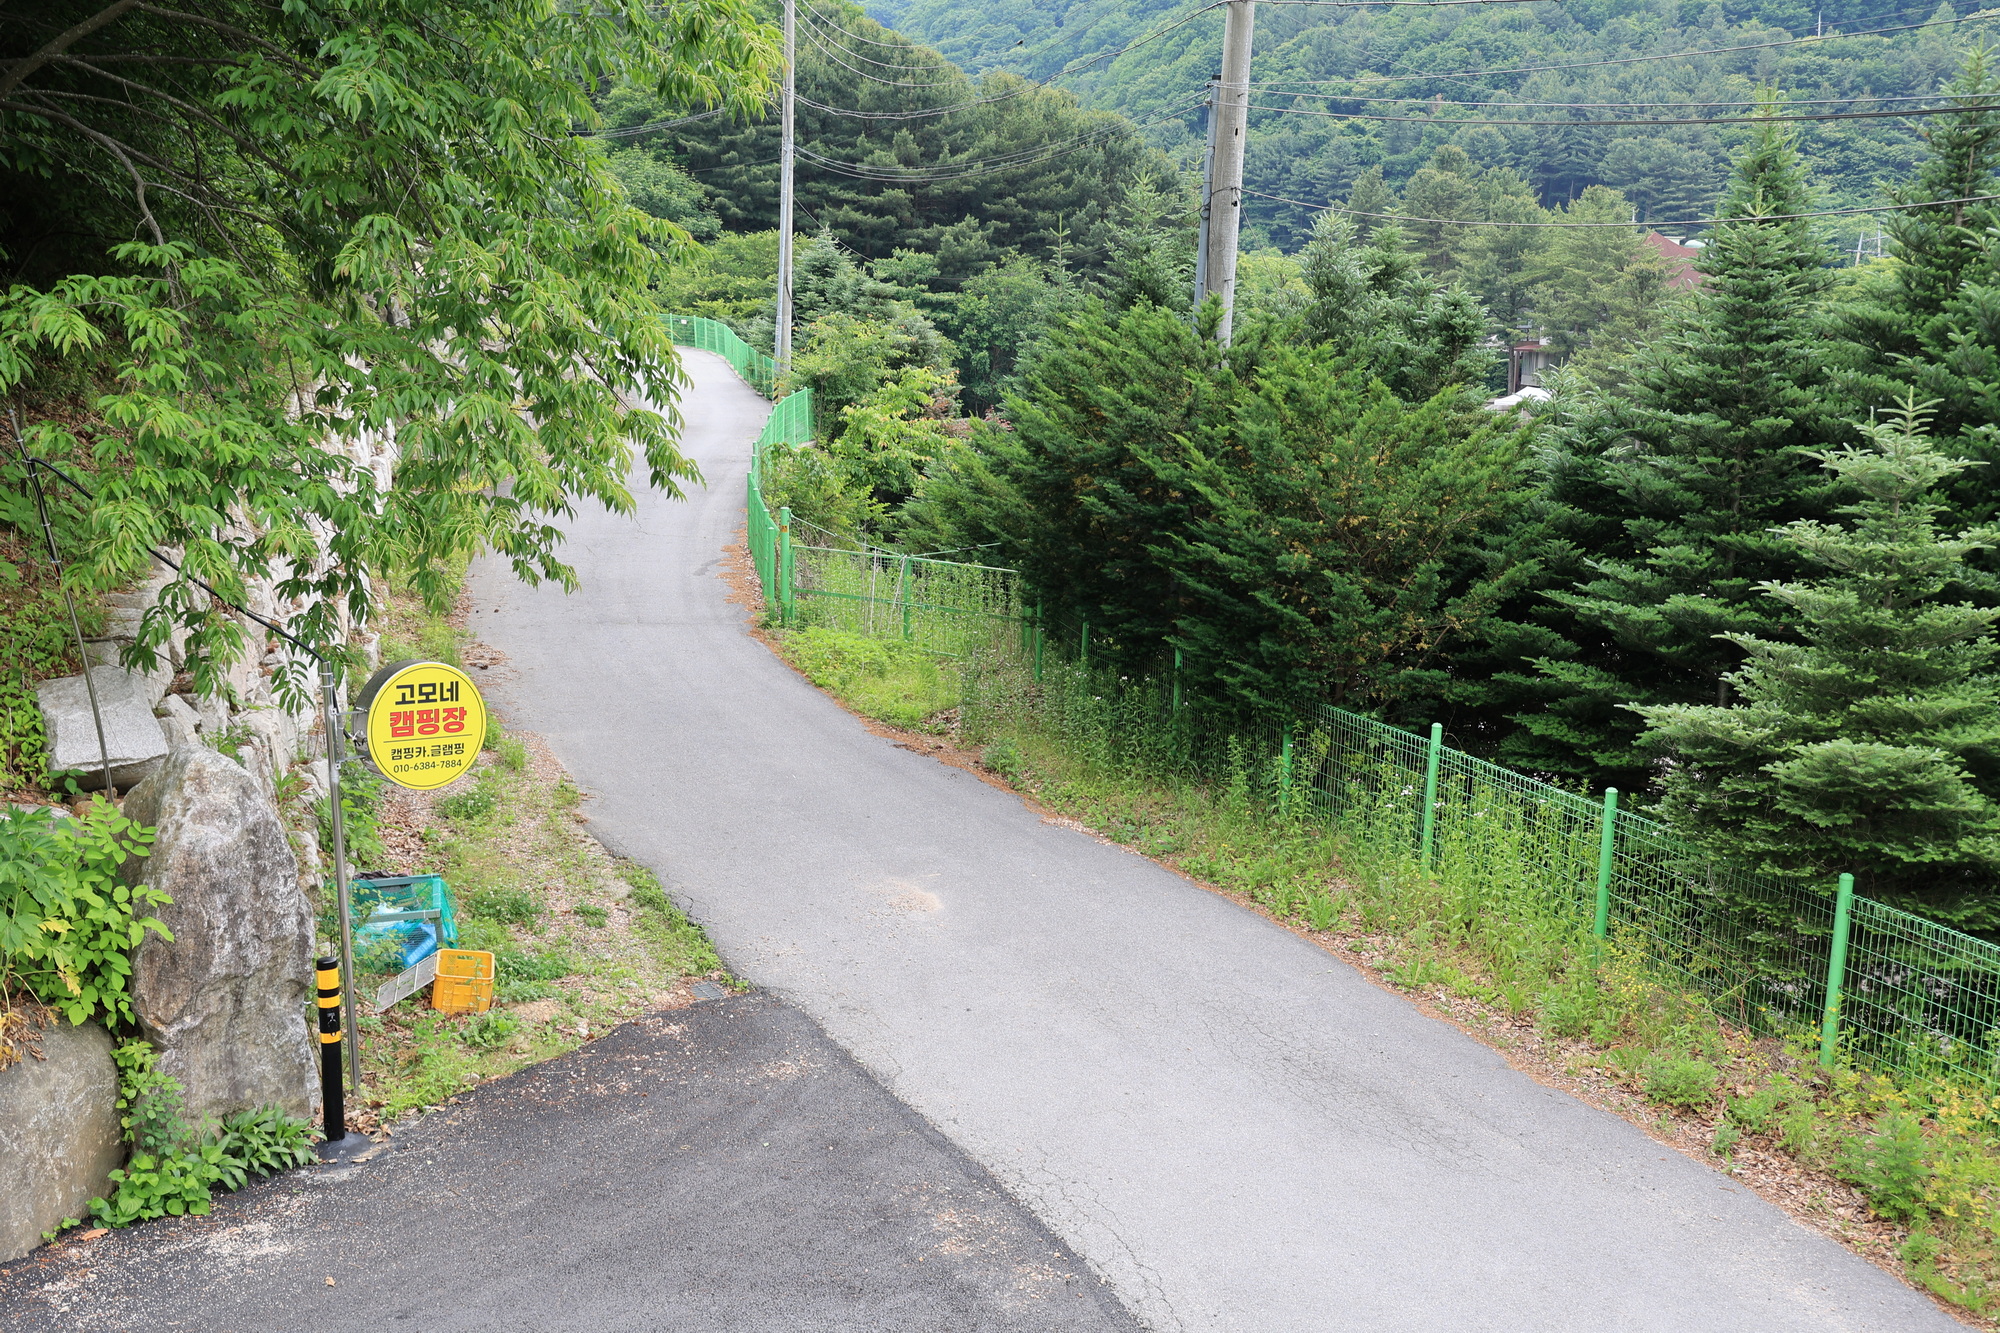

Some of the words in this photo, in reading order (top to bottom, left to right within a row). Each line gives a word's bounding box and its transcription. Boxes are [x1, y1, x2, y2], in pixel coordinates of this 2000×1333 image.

[395, 681, 458, 704] 고모네
[390, 707, 467, 737] 캠핑장
[391, 743, 465, 760] 캠핑카.글램핑
[393, 759, 462, 773] 010-6384-7884
